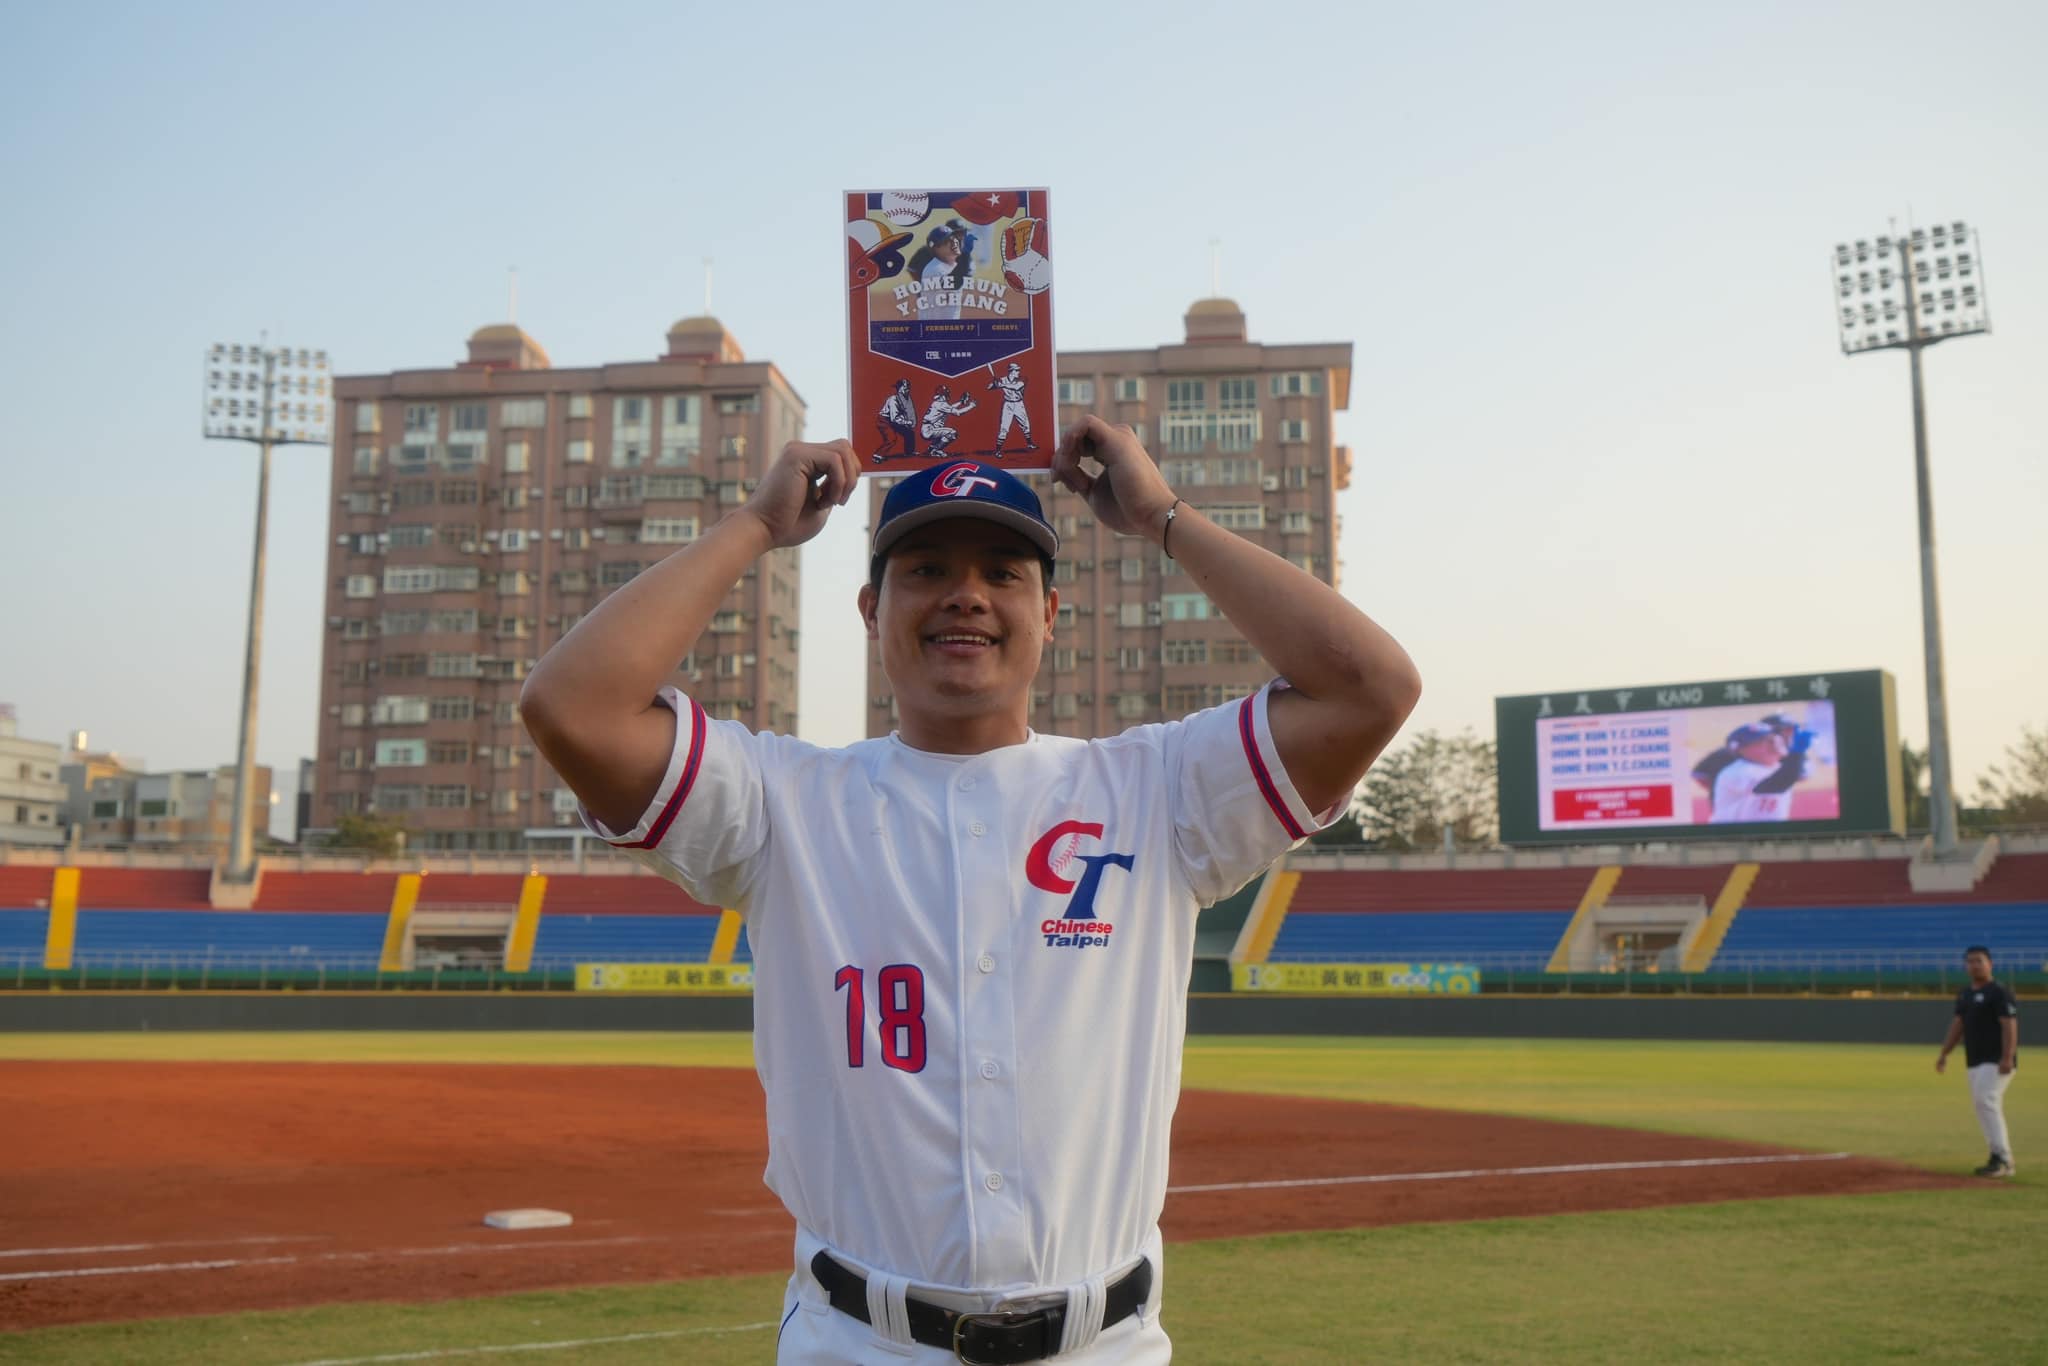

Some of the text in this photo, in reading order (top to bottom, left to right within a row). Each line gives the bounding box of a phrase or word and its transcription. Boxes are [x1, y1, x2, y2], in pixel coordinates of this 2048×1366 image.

[893, 276, 1007, 300] HOME RUN
[896, 293, 1008, 316] Y.C.CHANG
[1657, 687, 1704, 707] KANO
[1025, 819, 1135, 919] CT
[1041, 919, 1113, 934] Chinese
[1044, 934, 1109, 949] Taipei
[834, 964, 927, 1073] 18
